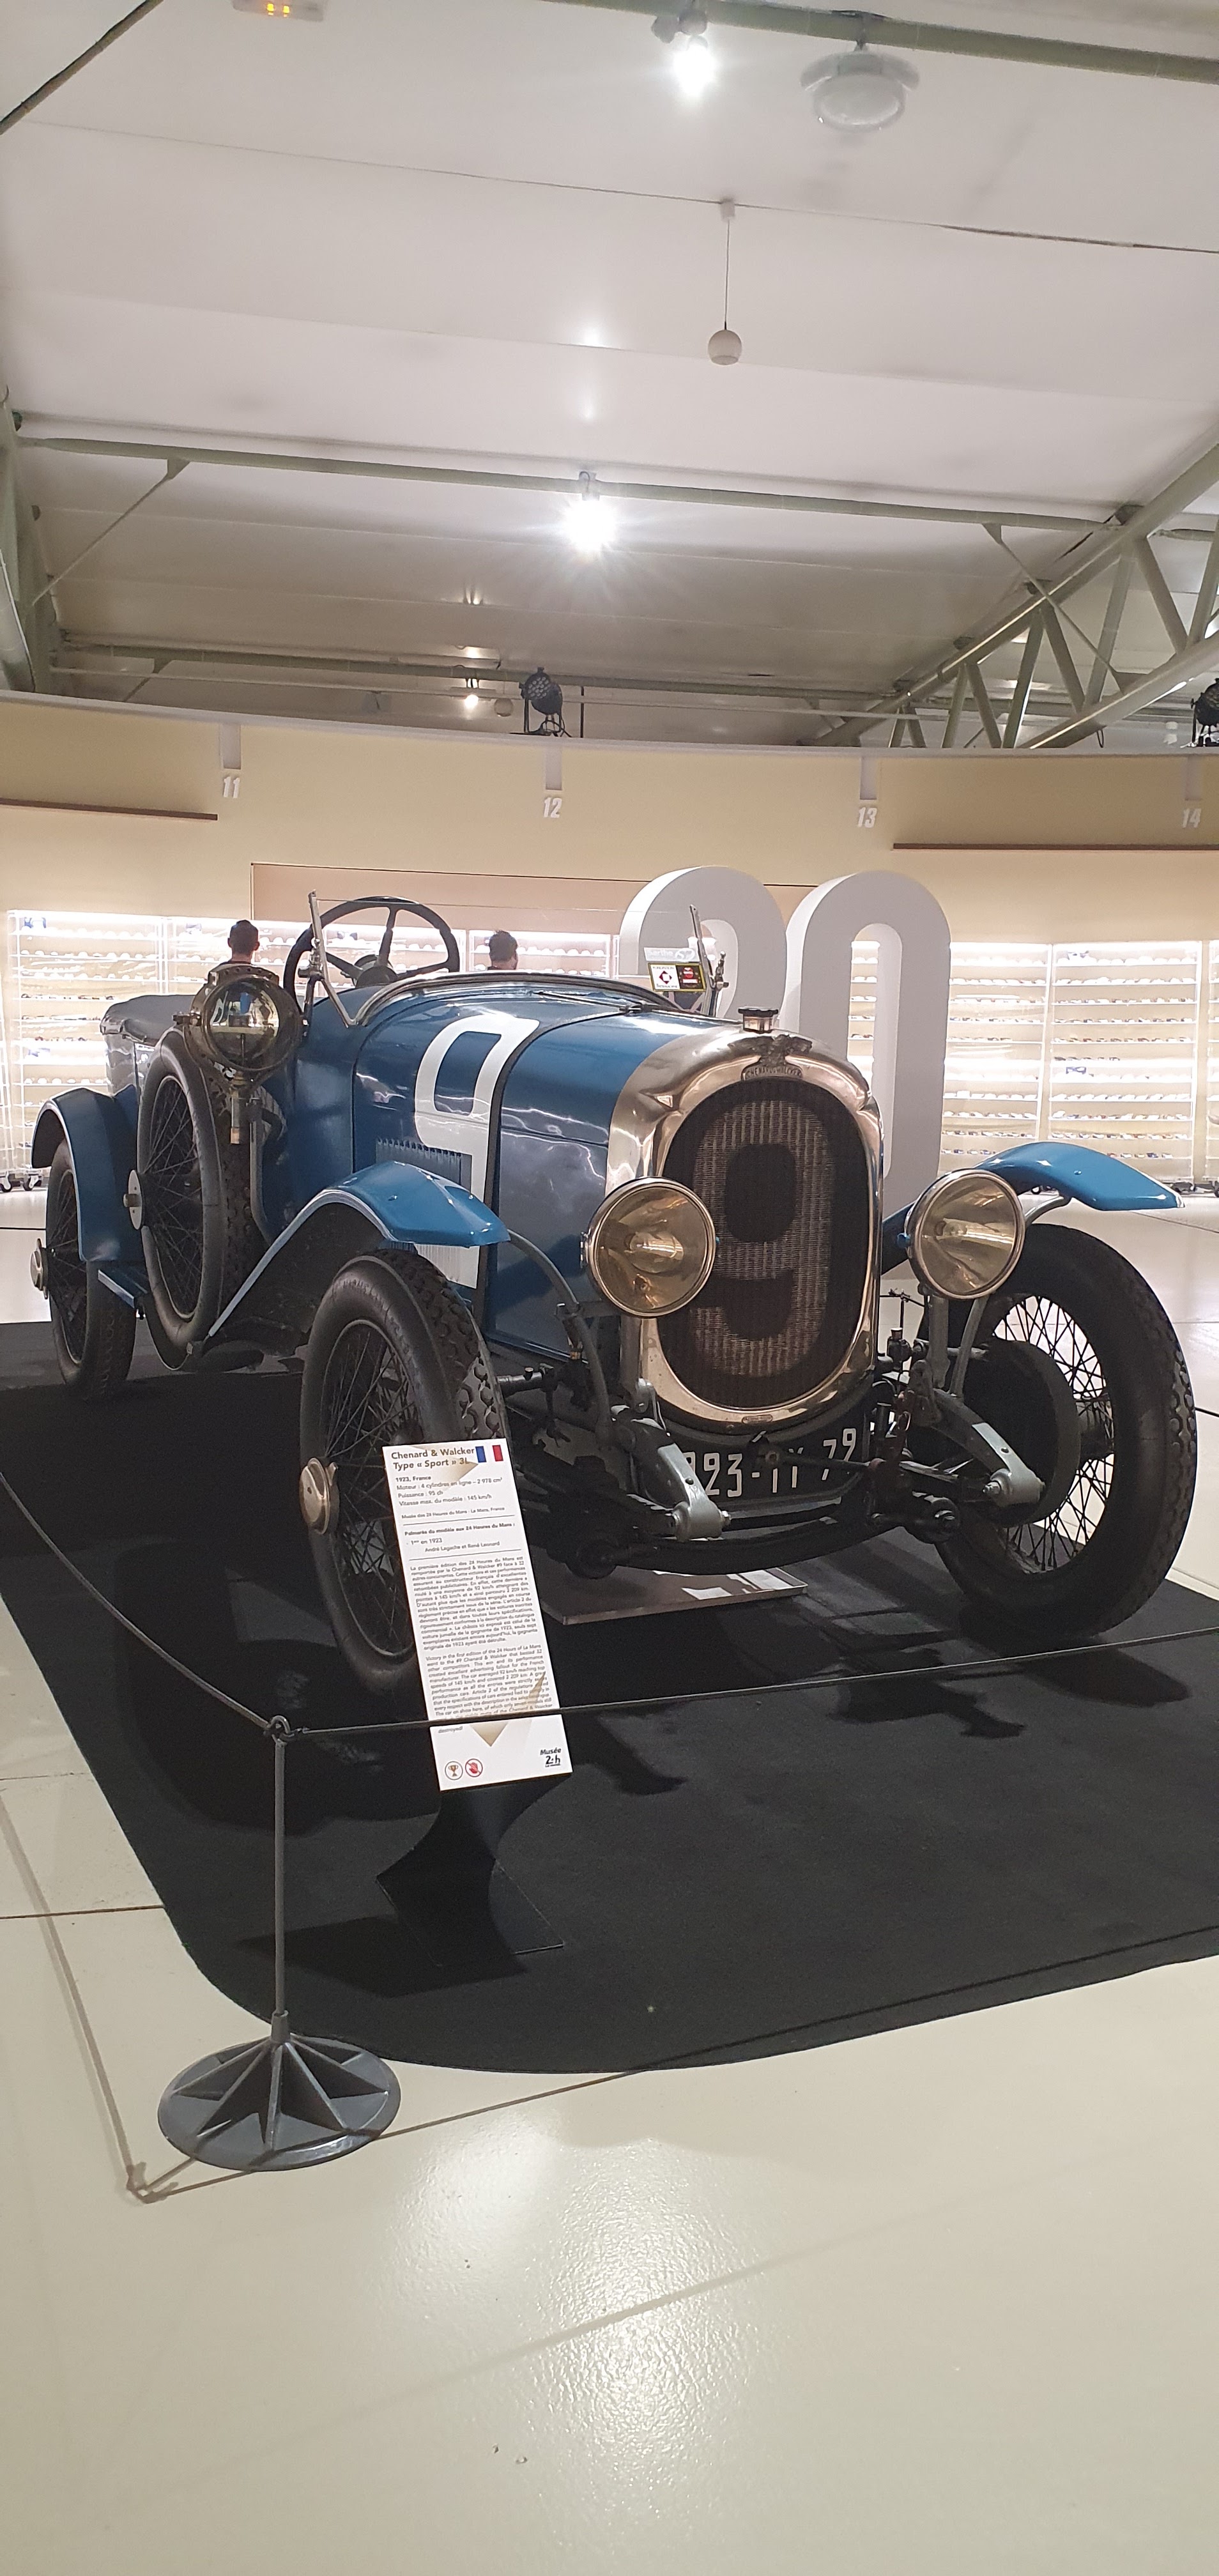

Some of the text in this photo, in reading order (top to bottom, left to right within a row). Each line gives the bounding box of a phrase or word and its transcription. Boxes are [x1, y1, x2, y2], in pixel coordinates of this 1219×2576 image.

[223, 776, 240, 799] 11
[543, 797, 563, 818] 12
[858, 807, 877, 829] 13
[1183, 808, 1202, 829] 14
[690, 1100, 833, 1377] 9
[391, 1449, 428, 1459] Chenard
[440, 1447, 474, 1455] Walcker
[392, 1462, 414, 1471] Type
[424, 1459, 449, 1469] Sport
[457, 1457, 470, 1466] 3L
[539, 1747, 561, 1755] Musée
